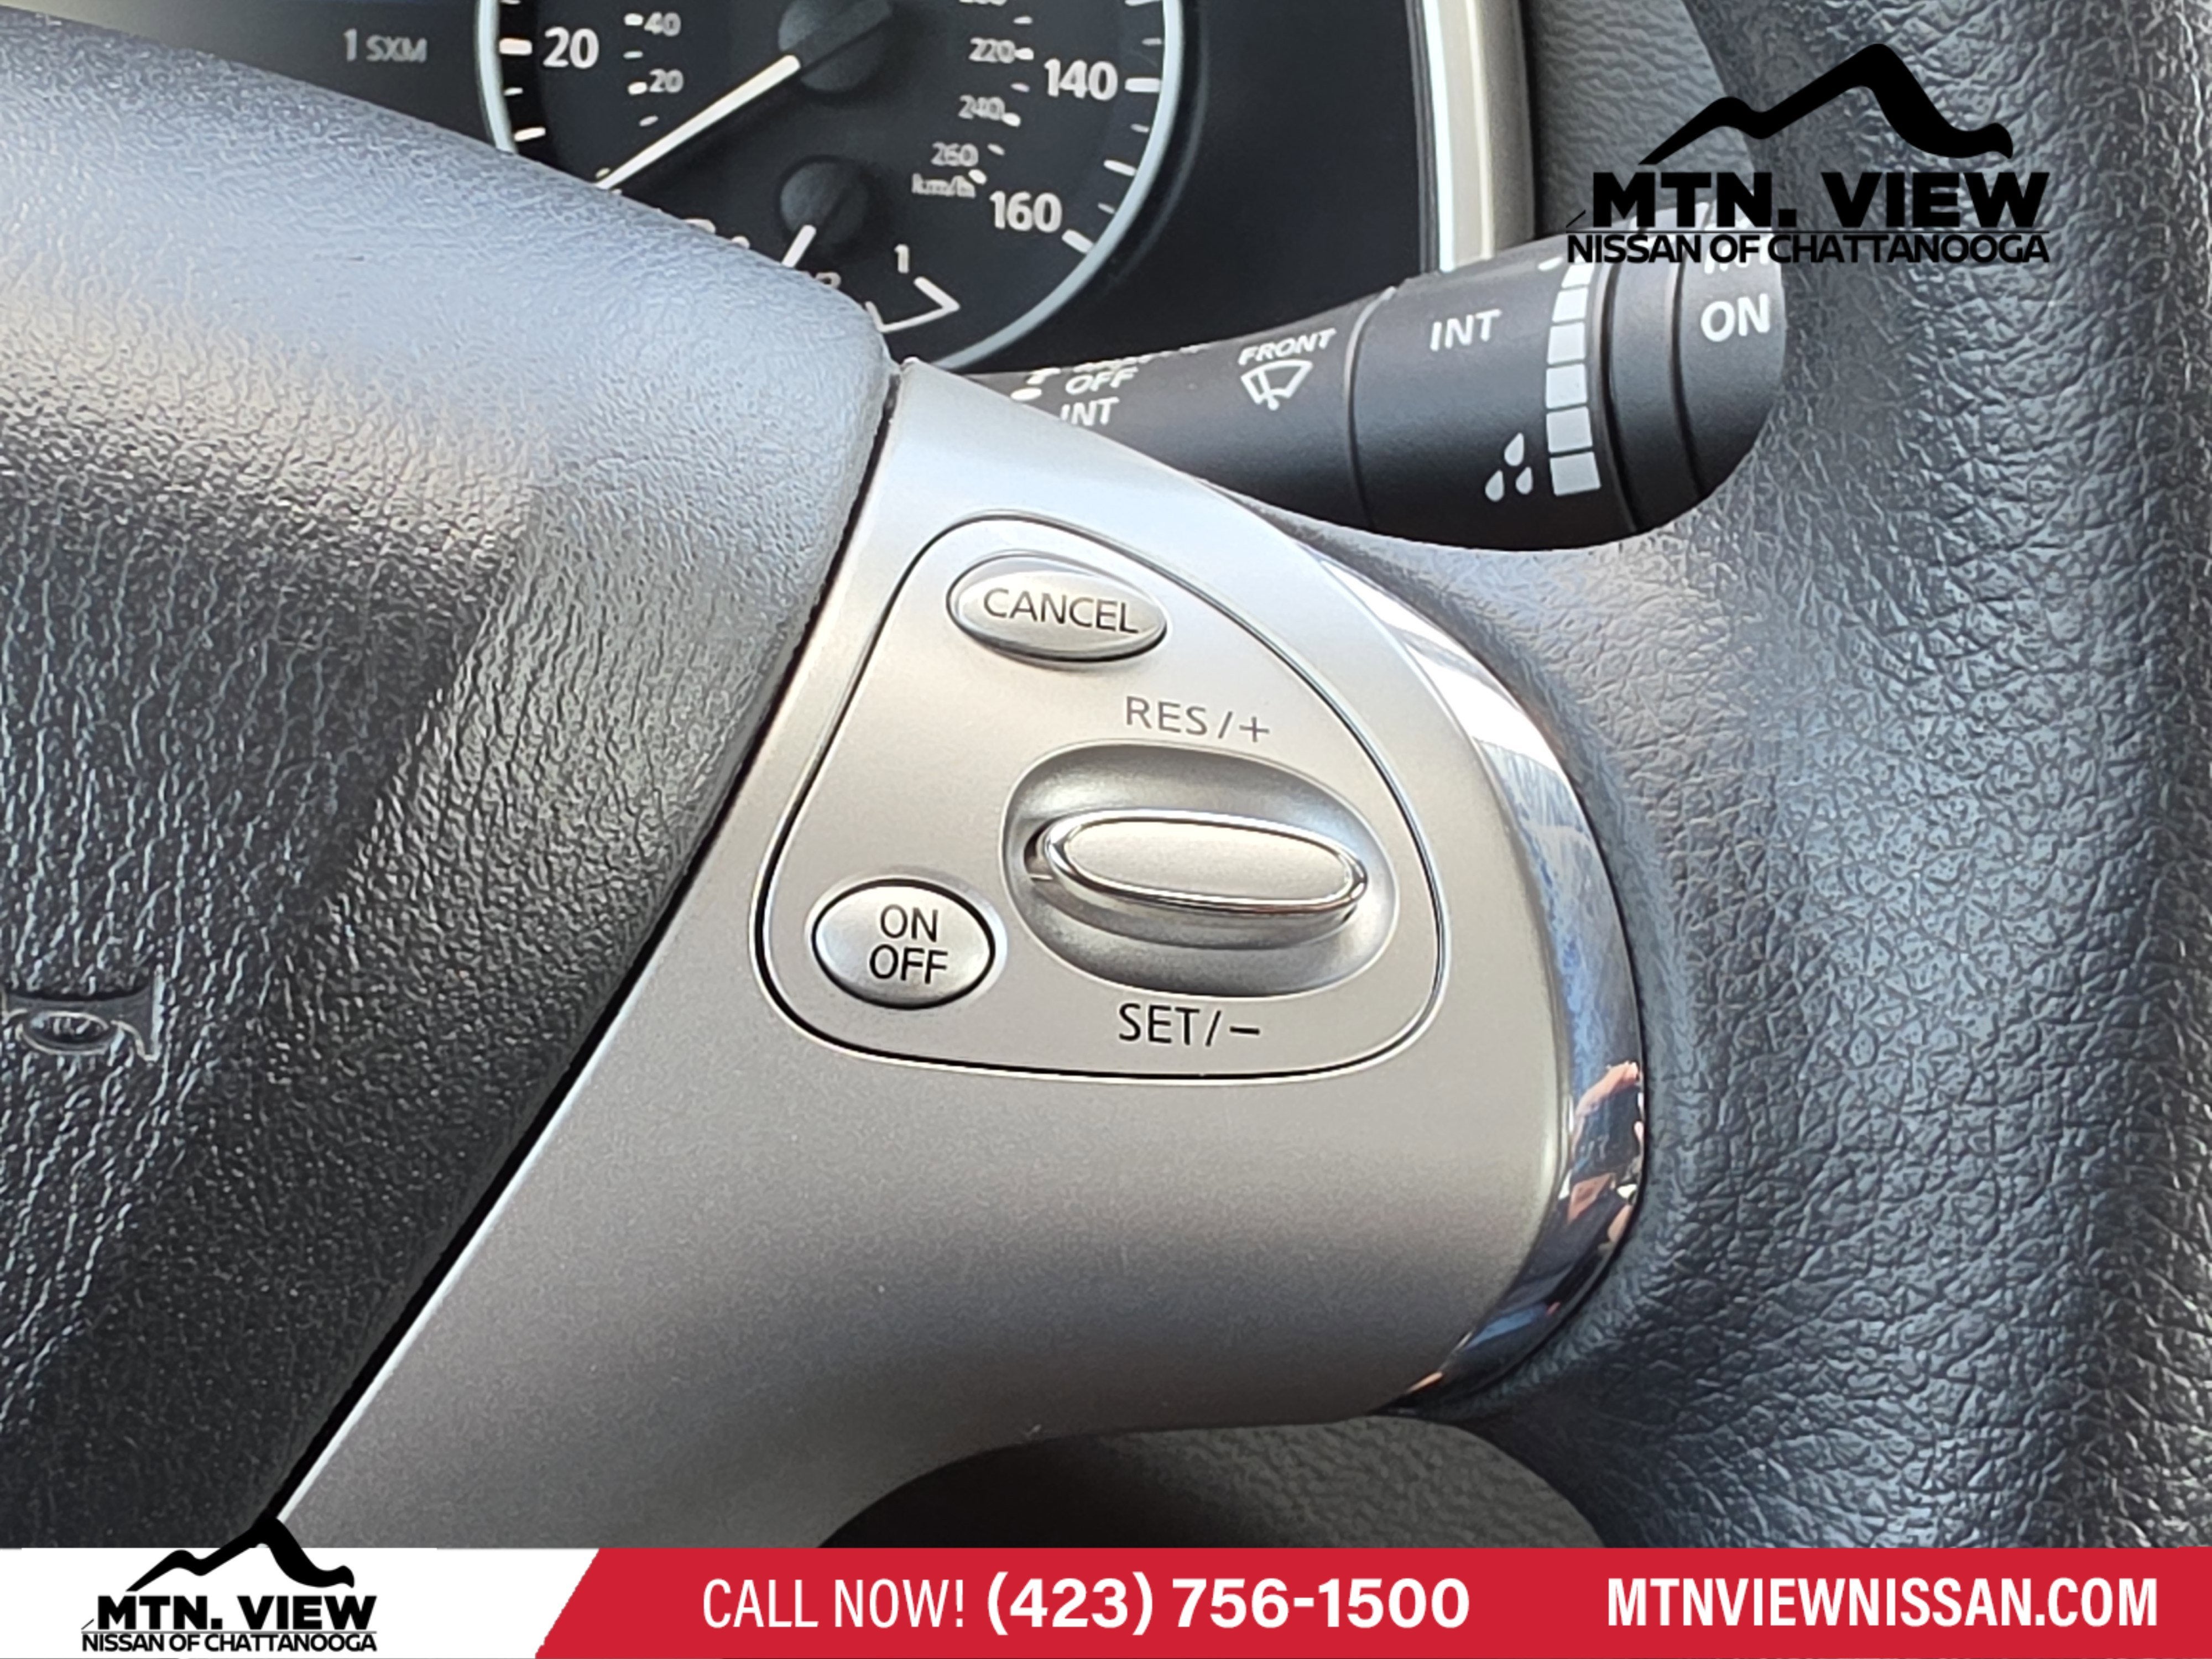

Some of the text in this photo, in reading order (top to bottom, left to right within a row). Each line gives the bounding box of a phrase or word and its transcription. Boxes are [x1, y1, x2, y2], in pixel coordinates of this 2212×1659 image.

[645, 12, 681, 36] 40
[343, 28, 427, 62] 1 SXM
[542, 26, 599, 69] 20
[968, 37, 1016, 64] 220
[649, 69, 684, 93] 20
[1044, 58, 1118, 101] 140
[958, 95, 1005, 121] 240
[989, 191, 1062, 233] 160
[1429, 308, 1503, 352] INT
[1700, 293, 1771, 343] ON
[1238, 328, 1337, 366] FRONT
[1065, 366, 1139, 401] OFF
[1060, 397, 1120, 427] INT
[982, 588, 1140, 635] CANCEL
[879, 905, 938, 942] ON
[868, 943, 948, 985] OFF
